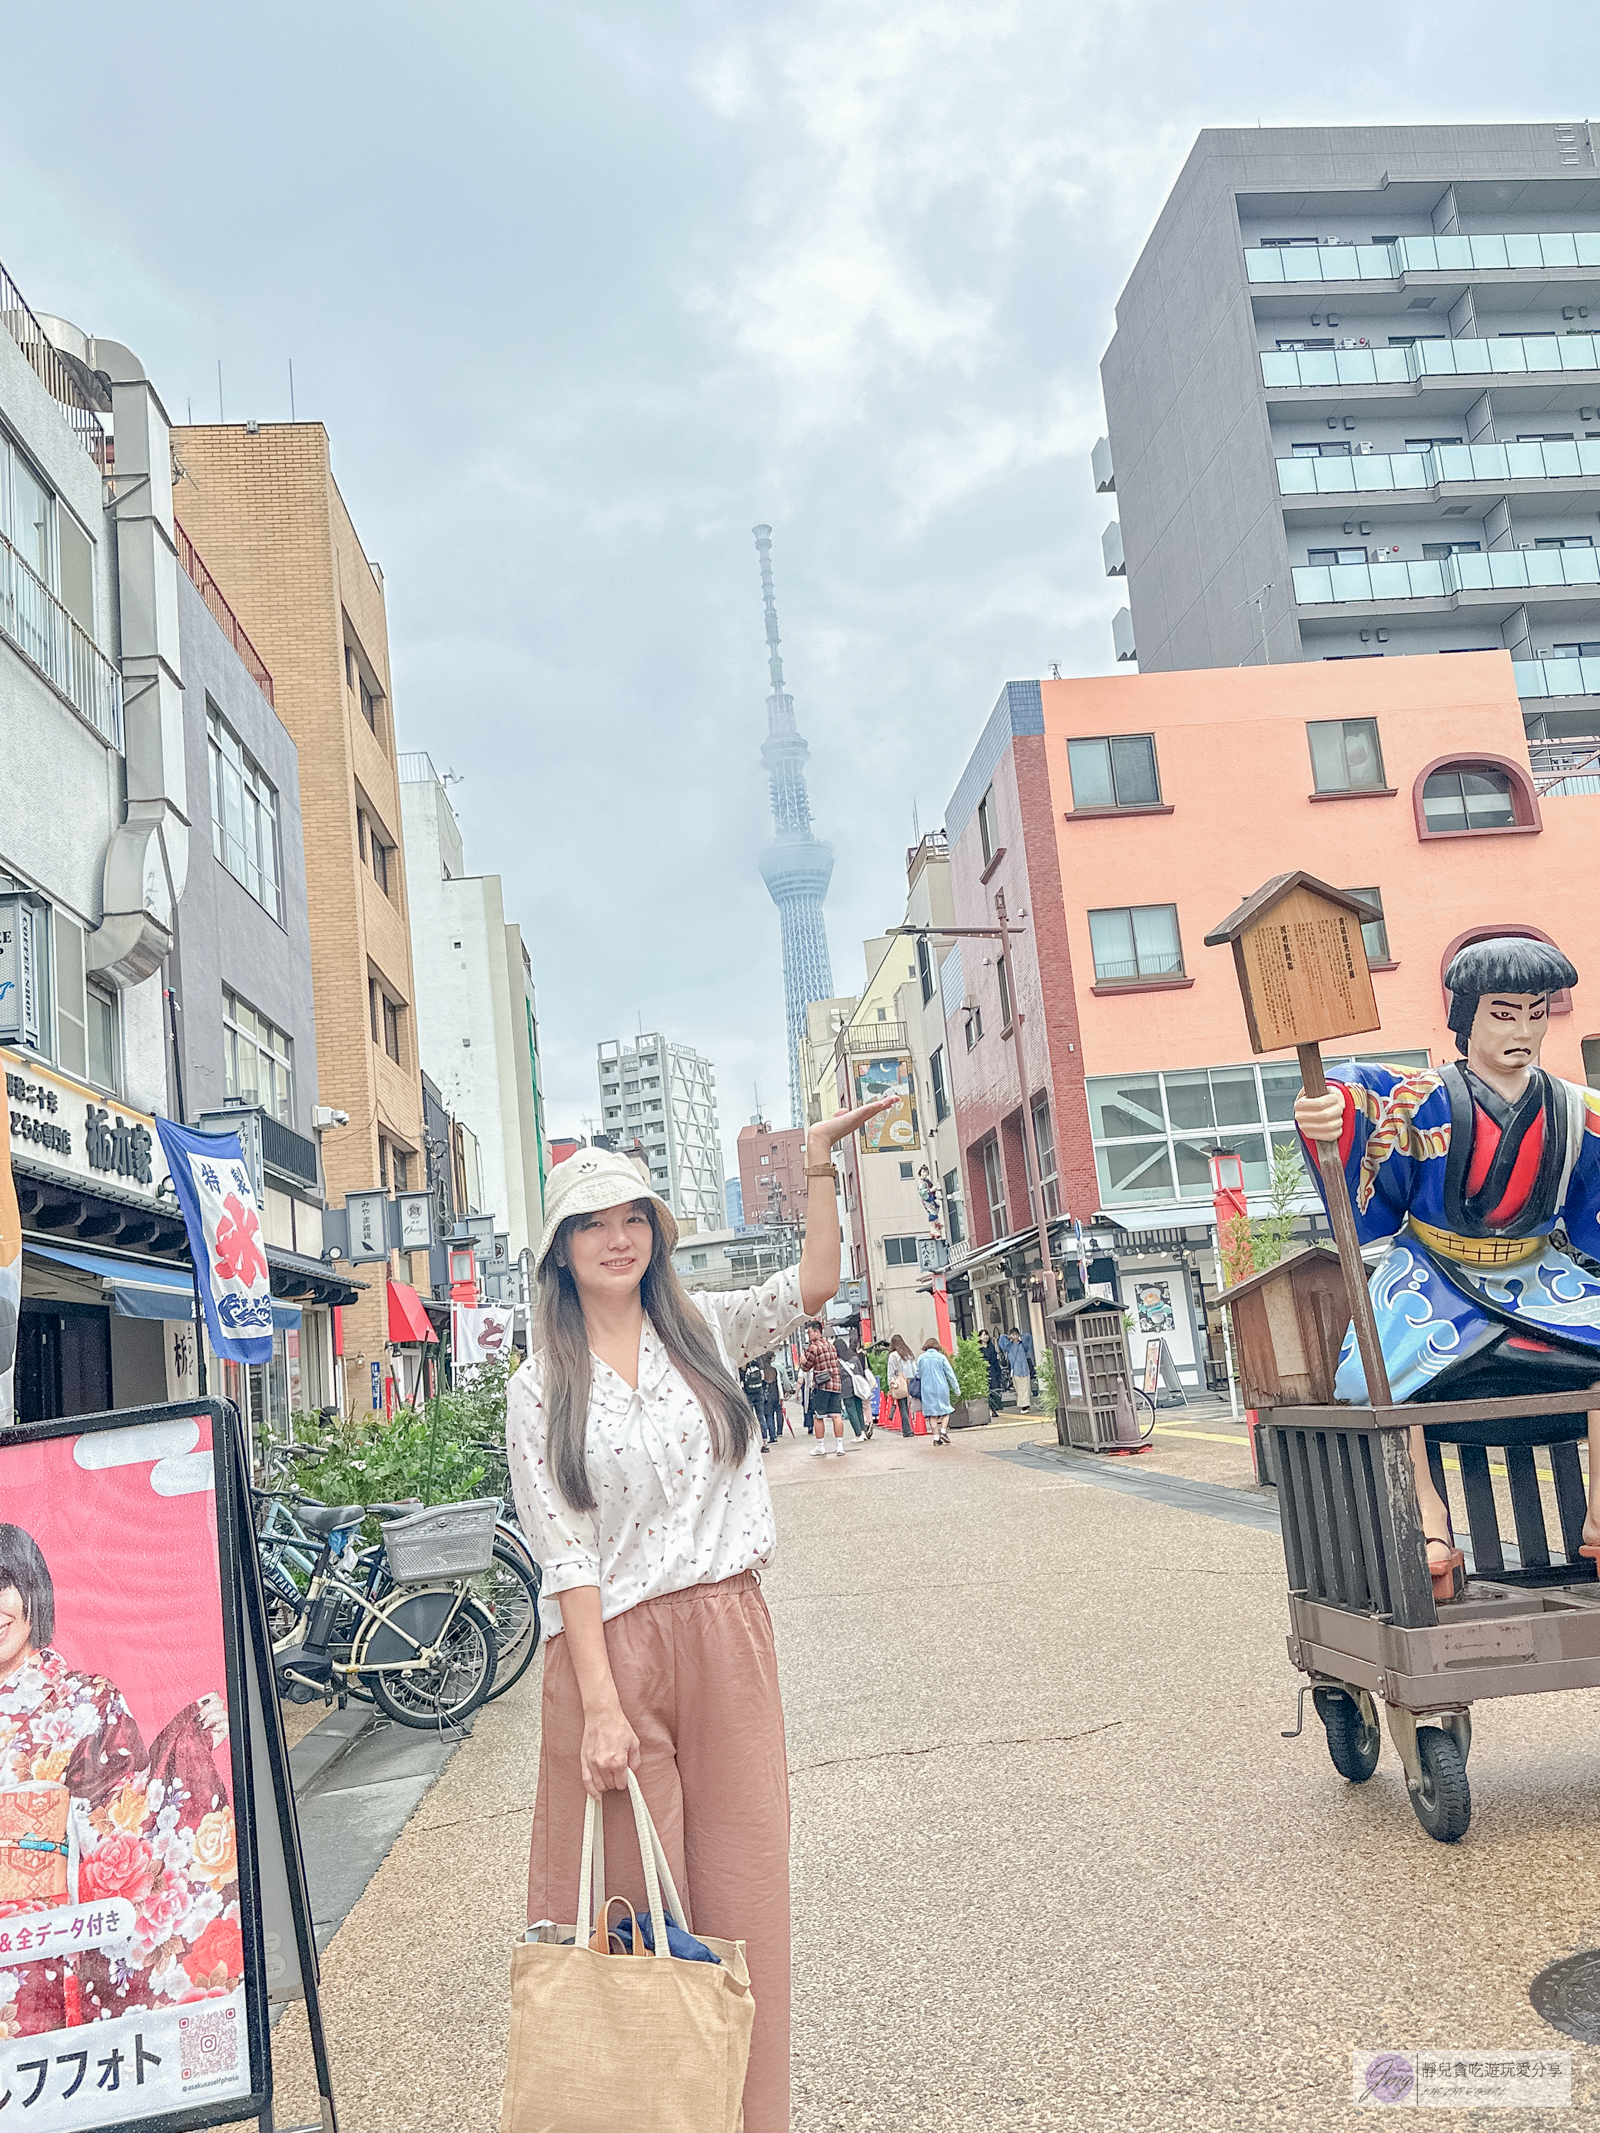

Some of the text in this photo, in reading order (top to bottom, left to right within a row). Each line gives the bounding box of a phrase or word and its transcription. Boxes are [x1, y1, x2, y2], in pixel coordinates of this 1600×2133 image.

[215, 1191, 268, 1289] 氷
[16, 1910, 120, 1951] 全データ付き
[0, 2033, 162, 2110] フフォト
